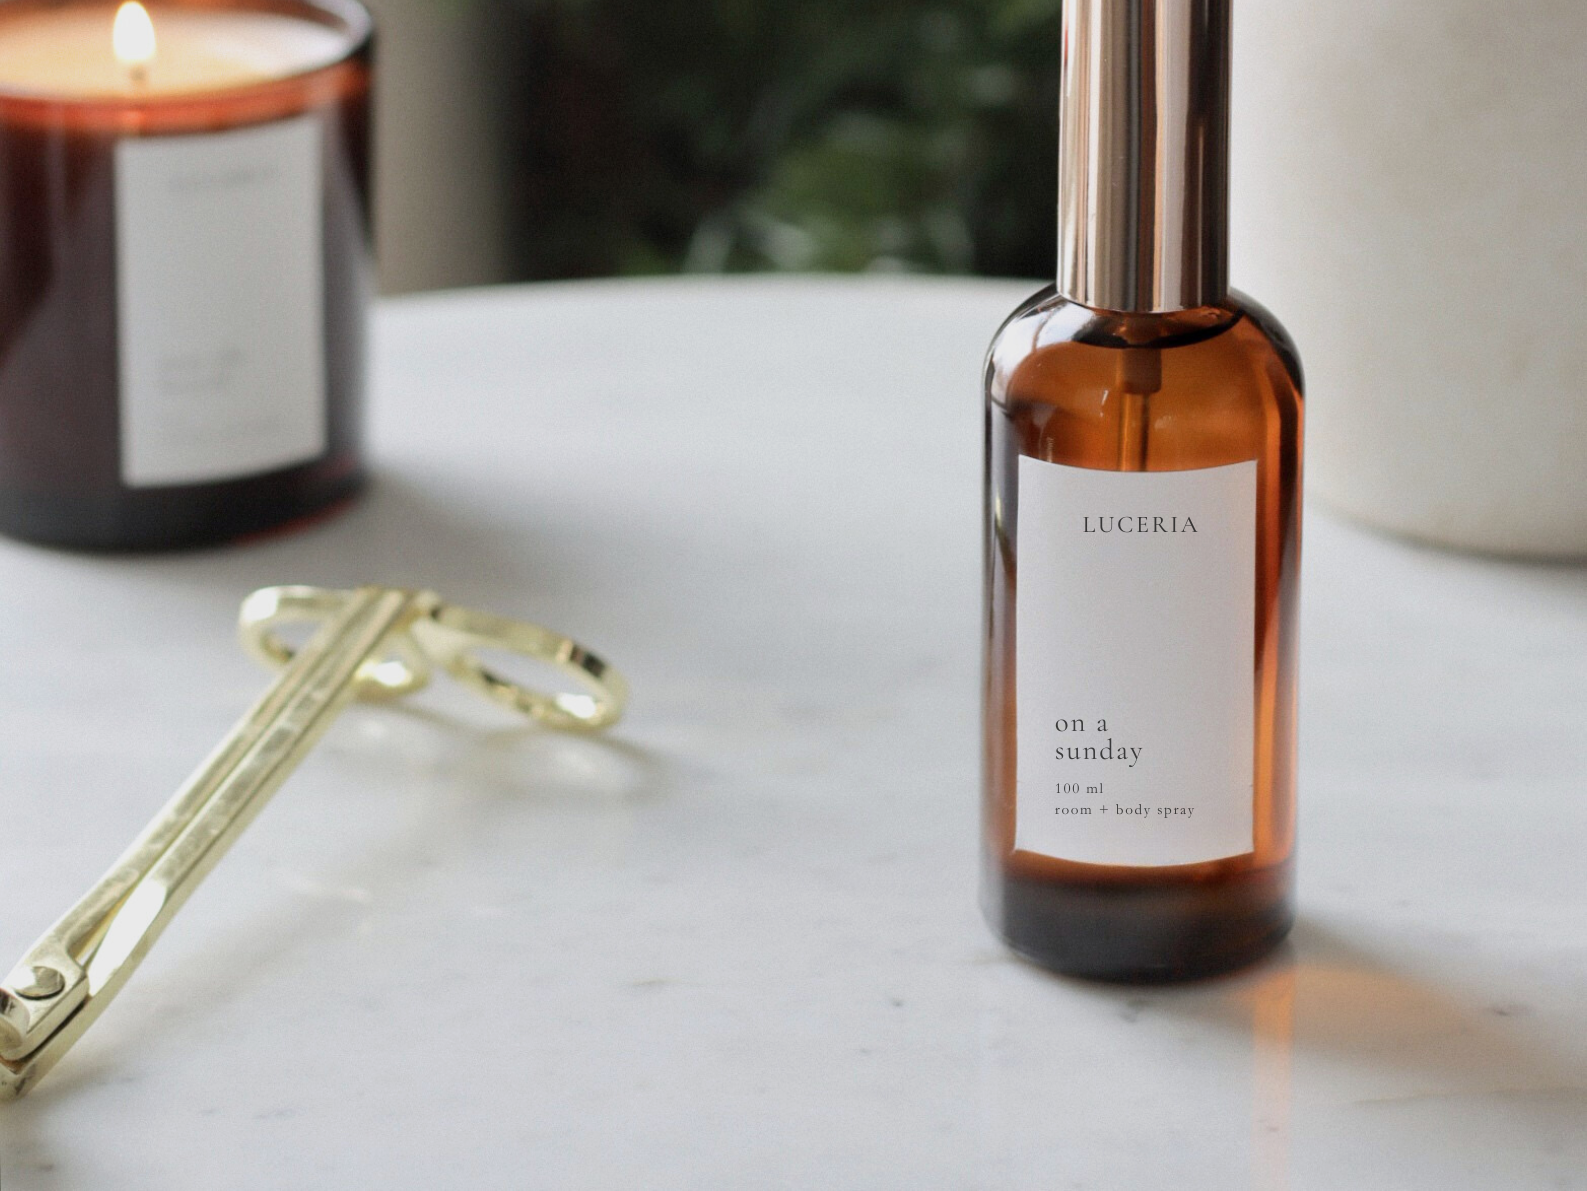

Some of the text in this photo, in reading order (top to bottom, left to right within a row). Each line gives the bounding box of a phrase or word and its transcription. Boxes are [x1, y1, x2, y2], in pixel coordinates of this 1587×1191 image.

[1083, 516, 1198, 533] LUCERIA
[1055, 718, 1109, 733] on a
[1055, 738, 1143, 768] sunday
[1055, 782, 1104, 795] 100 ml
[1055, 803, 1195, 820] room + body spray
